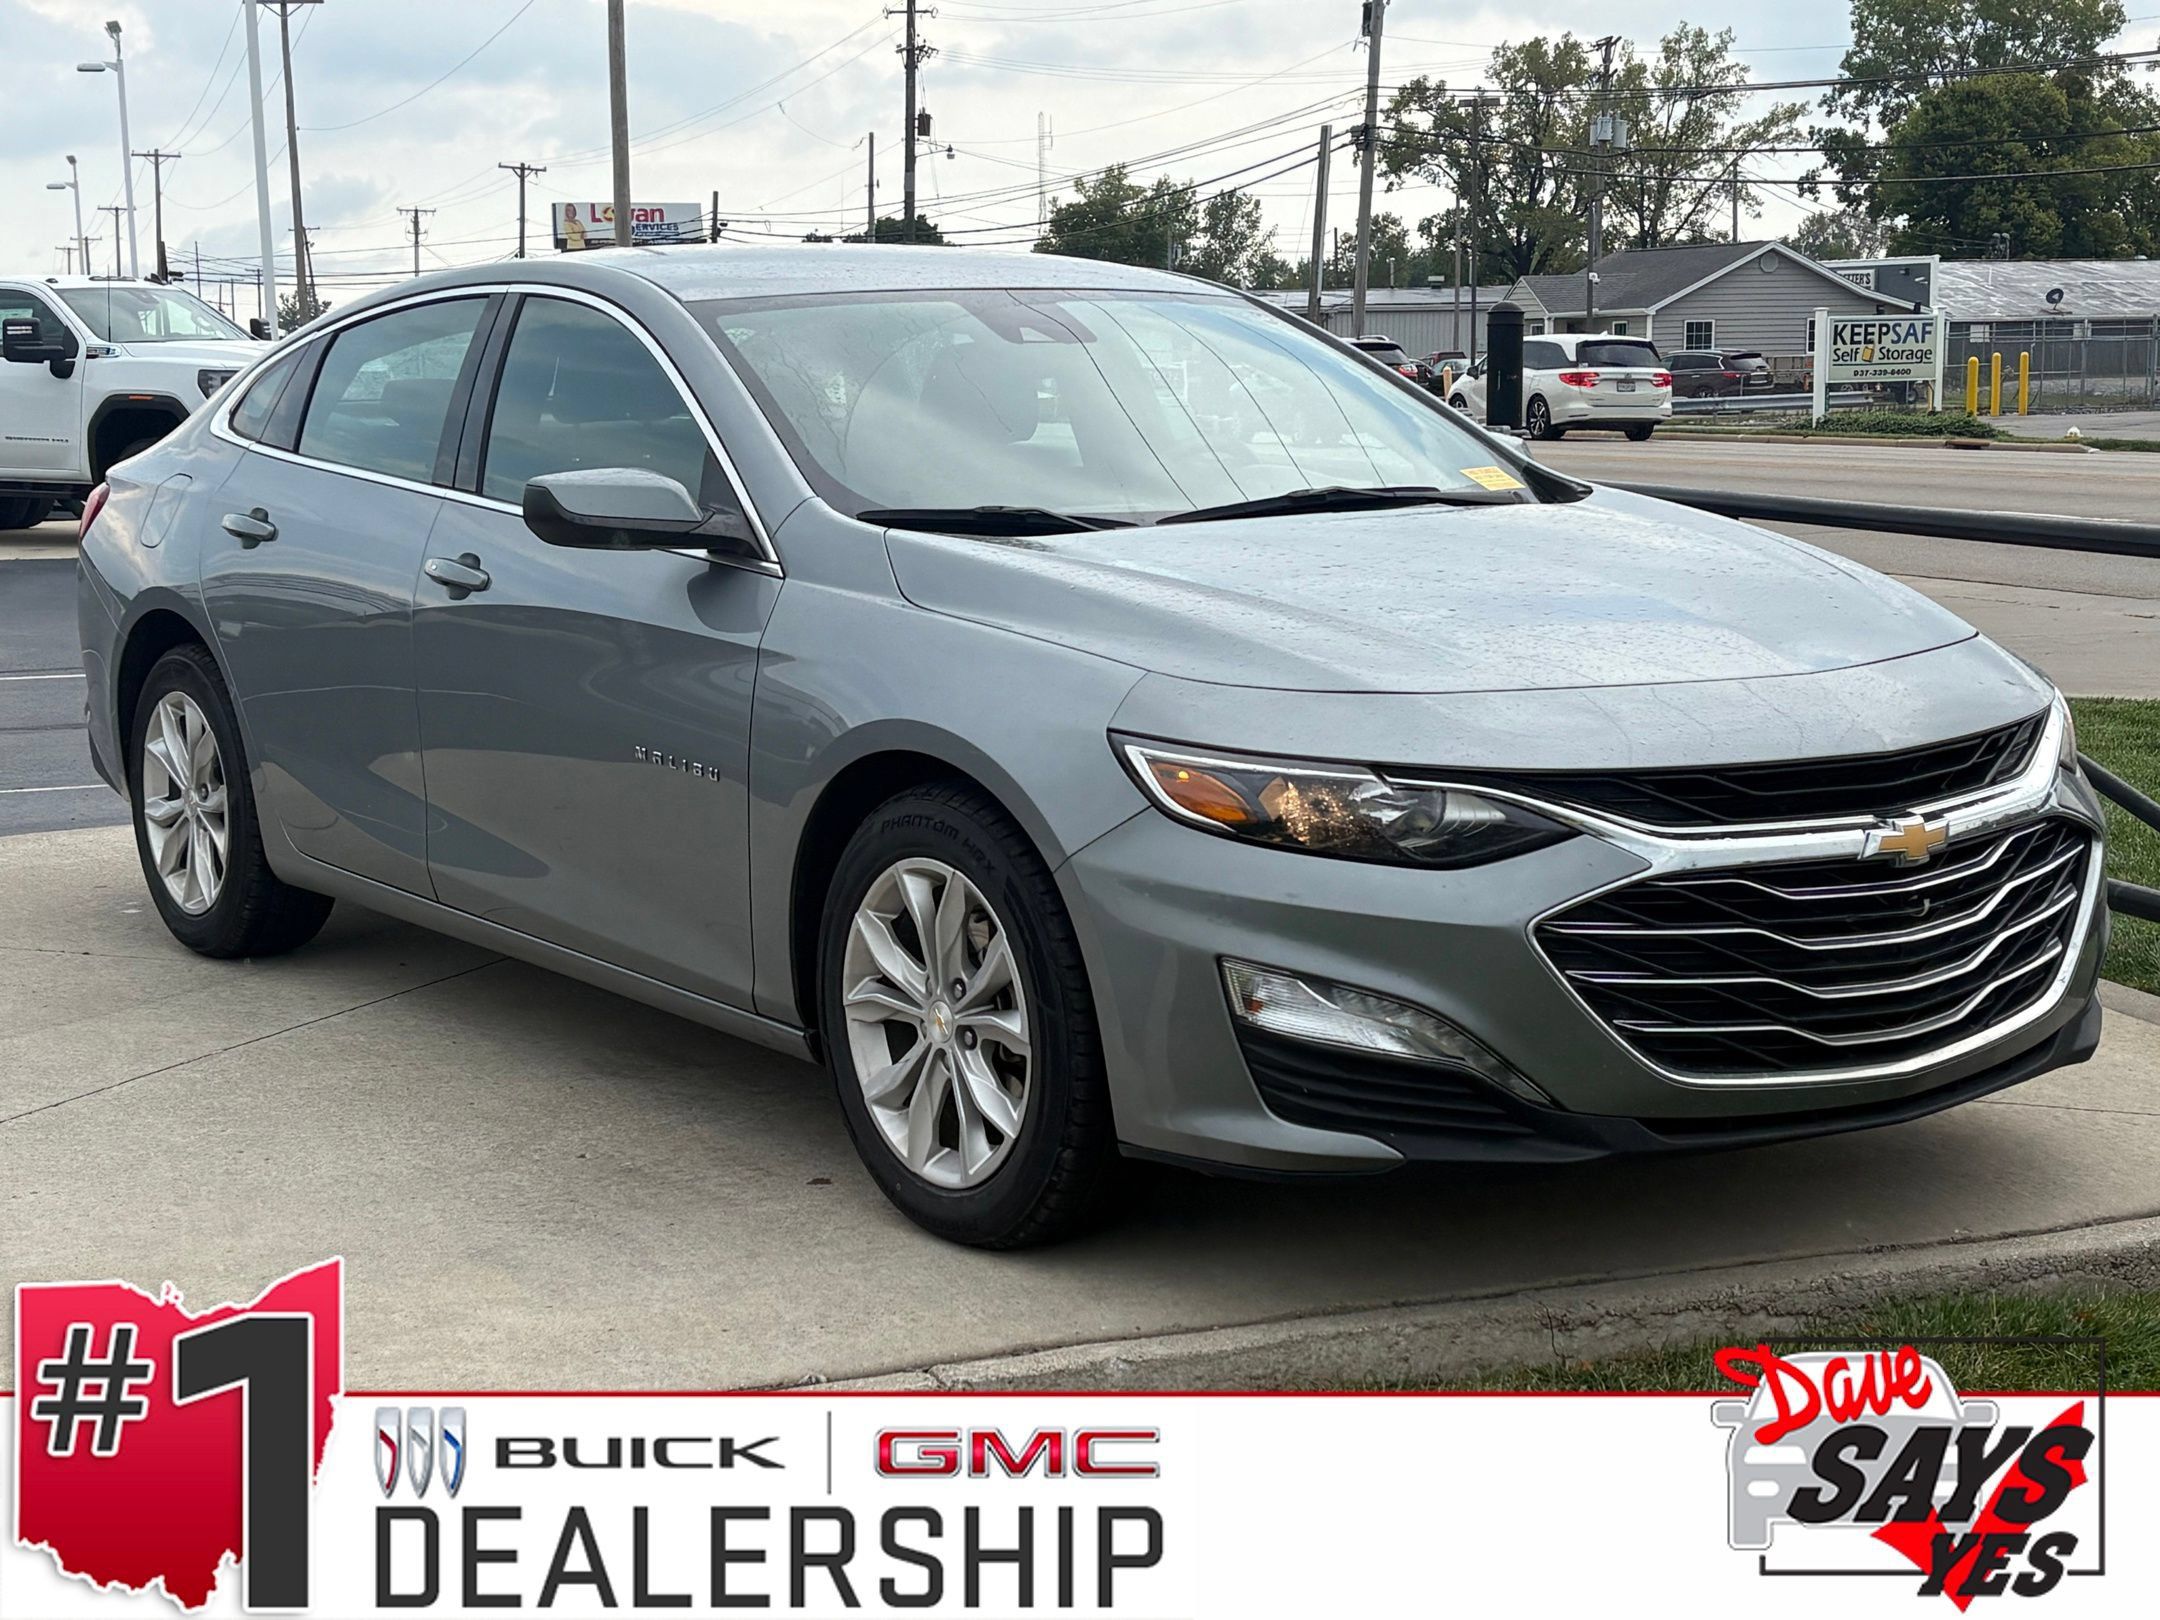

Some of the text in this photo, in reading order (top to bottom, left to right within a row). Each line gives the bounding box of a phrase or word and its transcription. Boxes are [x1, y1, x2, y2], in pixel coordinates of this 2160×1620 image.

[1832, 322, 1934, 345] KEEPSAF
[1832, 346, 1932, 363] Self Storage
[635, 745, 720, 782] MALIBU
[880, 814, 959, 840] PHANTOM
